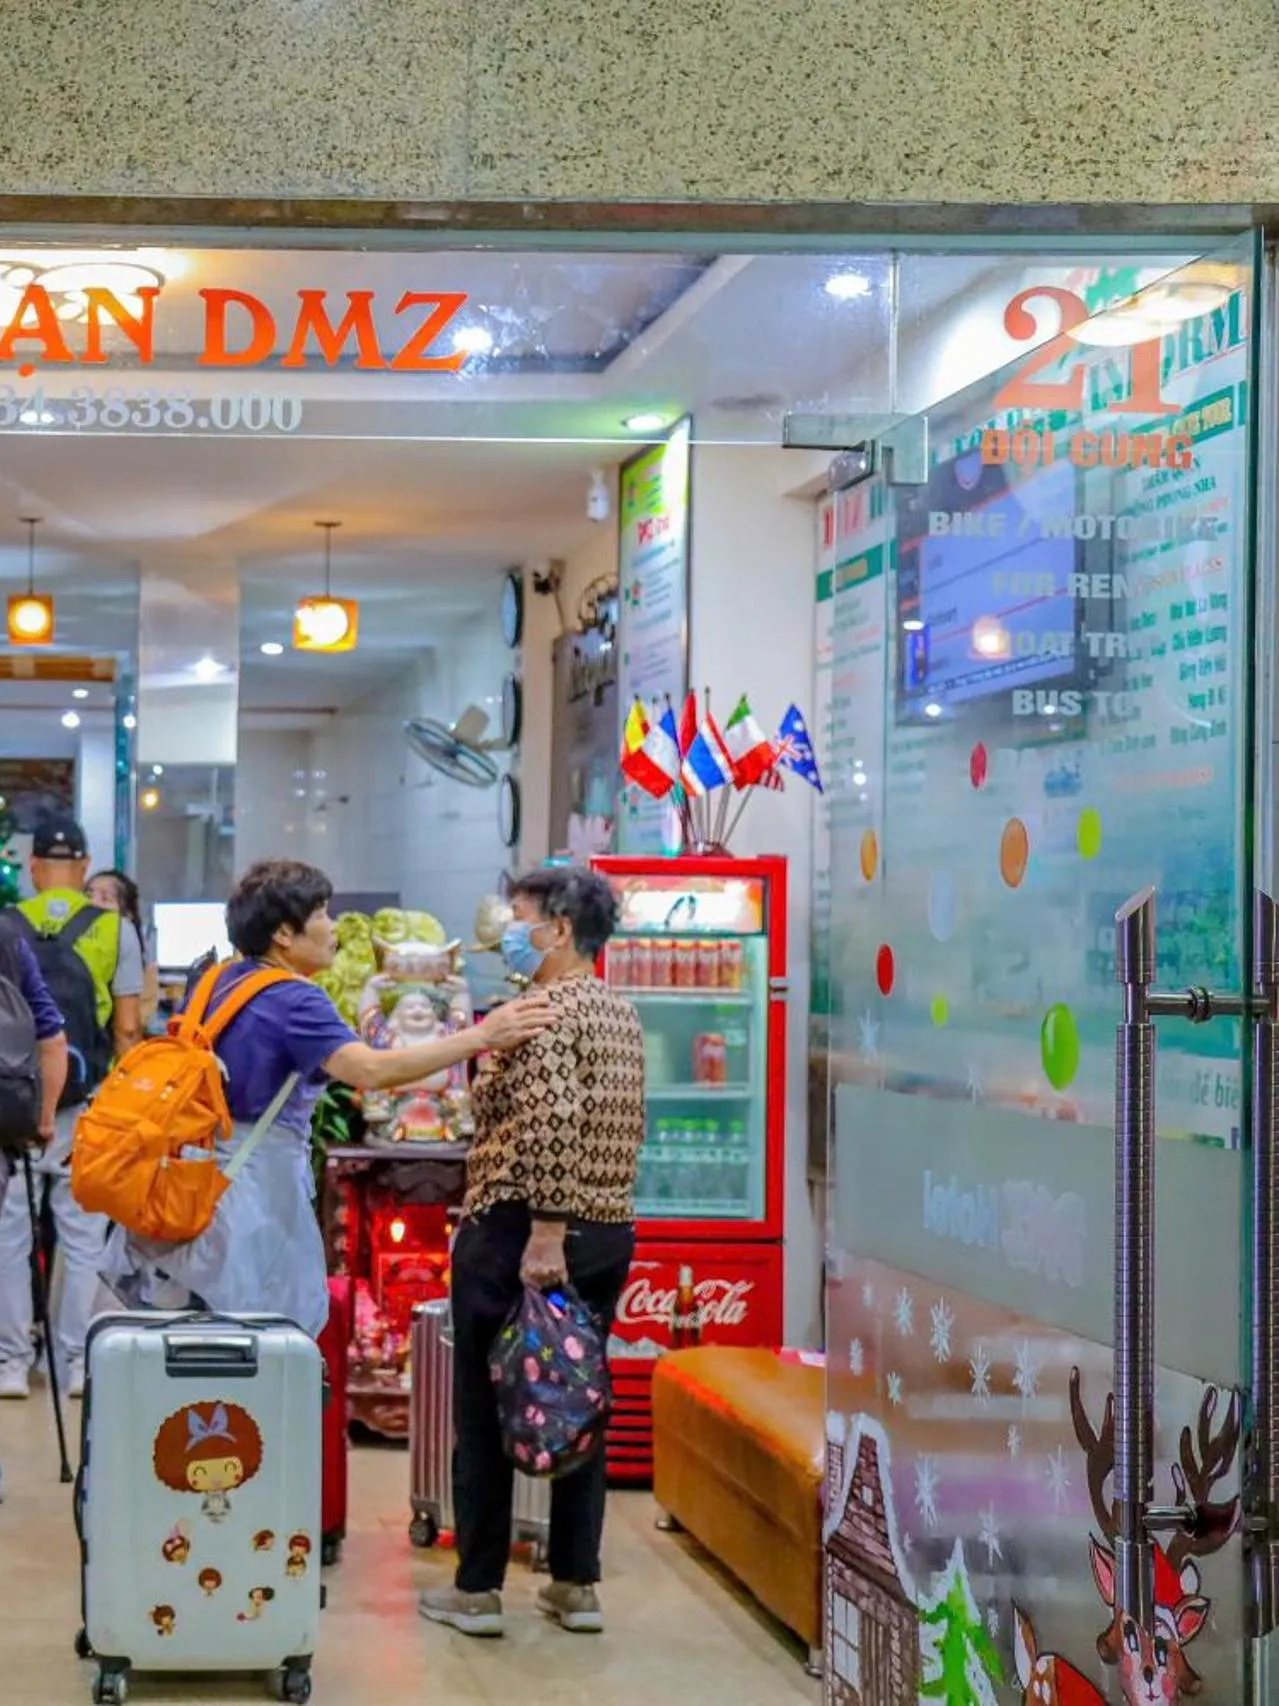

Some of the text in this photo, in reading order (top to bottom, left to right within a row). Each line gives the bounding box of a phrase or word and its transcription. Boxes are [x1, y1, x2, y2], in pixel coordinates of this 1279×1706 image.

[197, 288, 468, 372] DMZ
[993, 286, 1182, 414] 21
[981, 420, 1054, 481] ĐỘI
[1071, 431, 1193, 471] CUNG
[1068, 574, 1132, 599] REN
[1013, 690, 1081, 717] BUS
[616, 1278, 756, 1331] CocaCola
